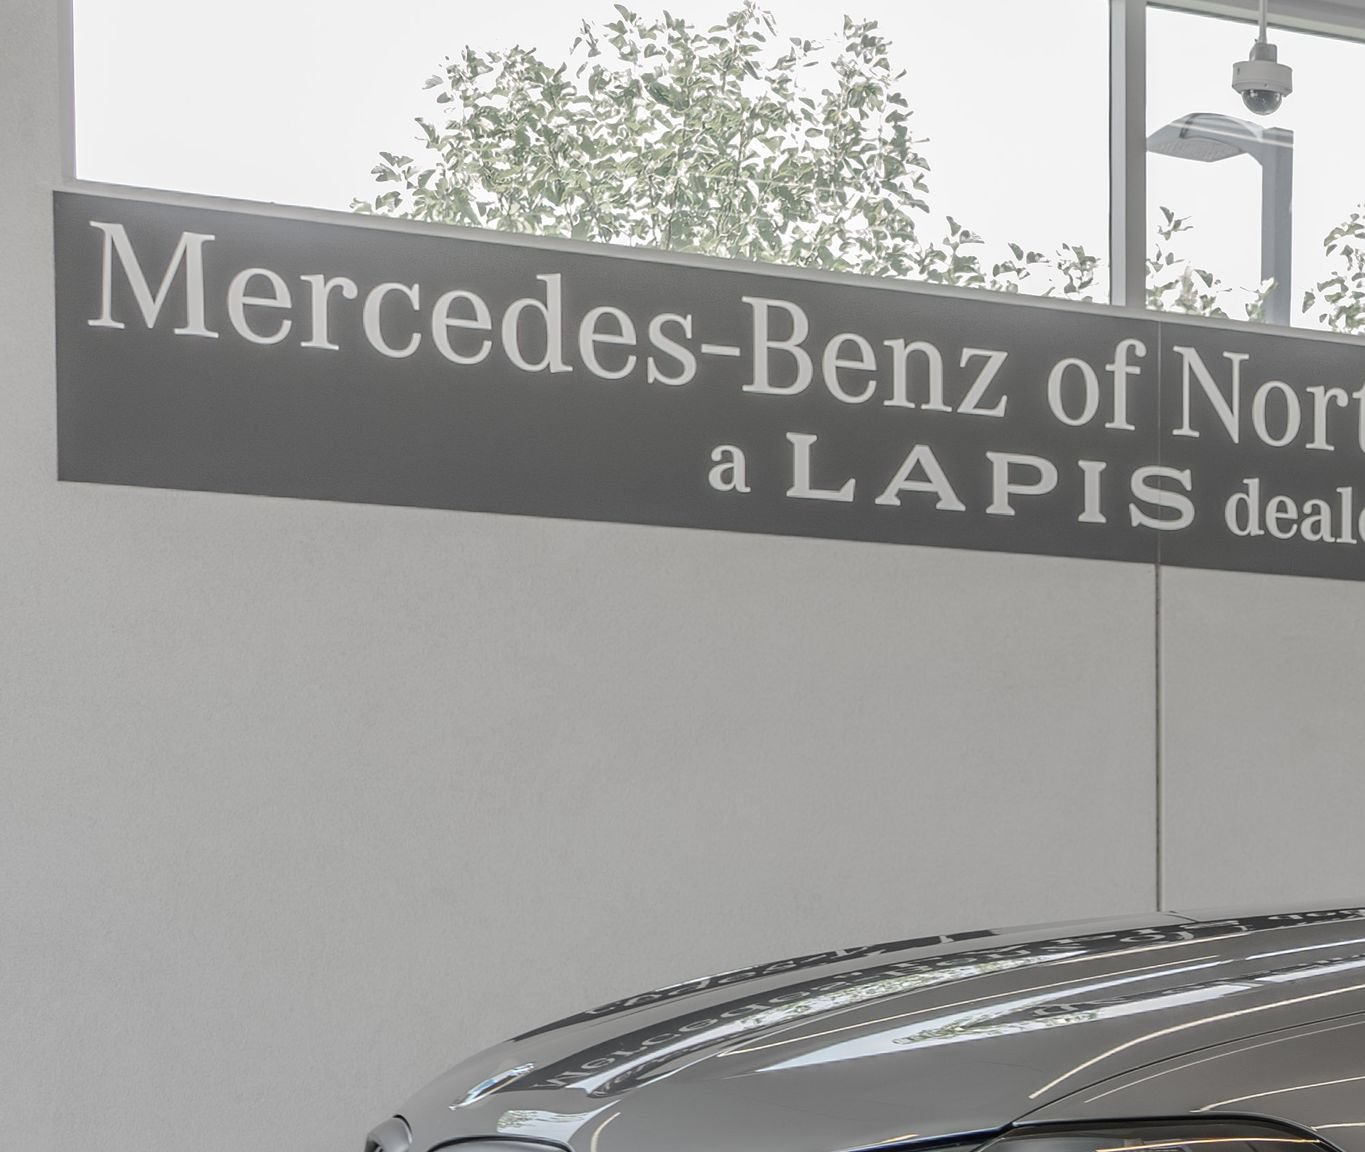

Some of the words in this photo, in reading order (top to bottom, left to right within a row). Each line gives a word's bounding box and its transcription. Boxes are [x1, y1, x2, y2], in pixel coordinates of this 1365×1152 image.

[88, 221, 1008, 417] Mercedes-Benz
[1048, 339, 1146, 430] of
[709, 445, 750, 492] a
[786, 432, 1194, 530] LAPIS
